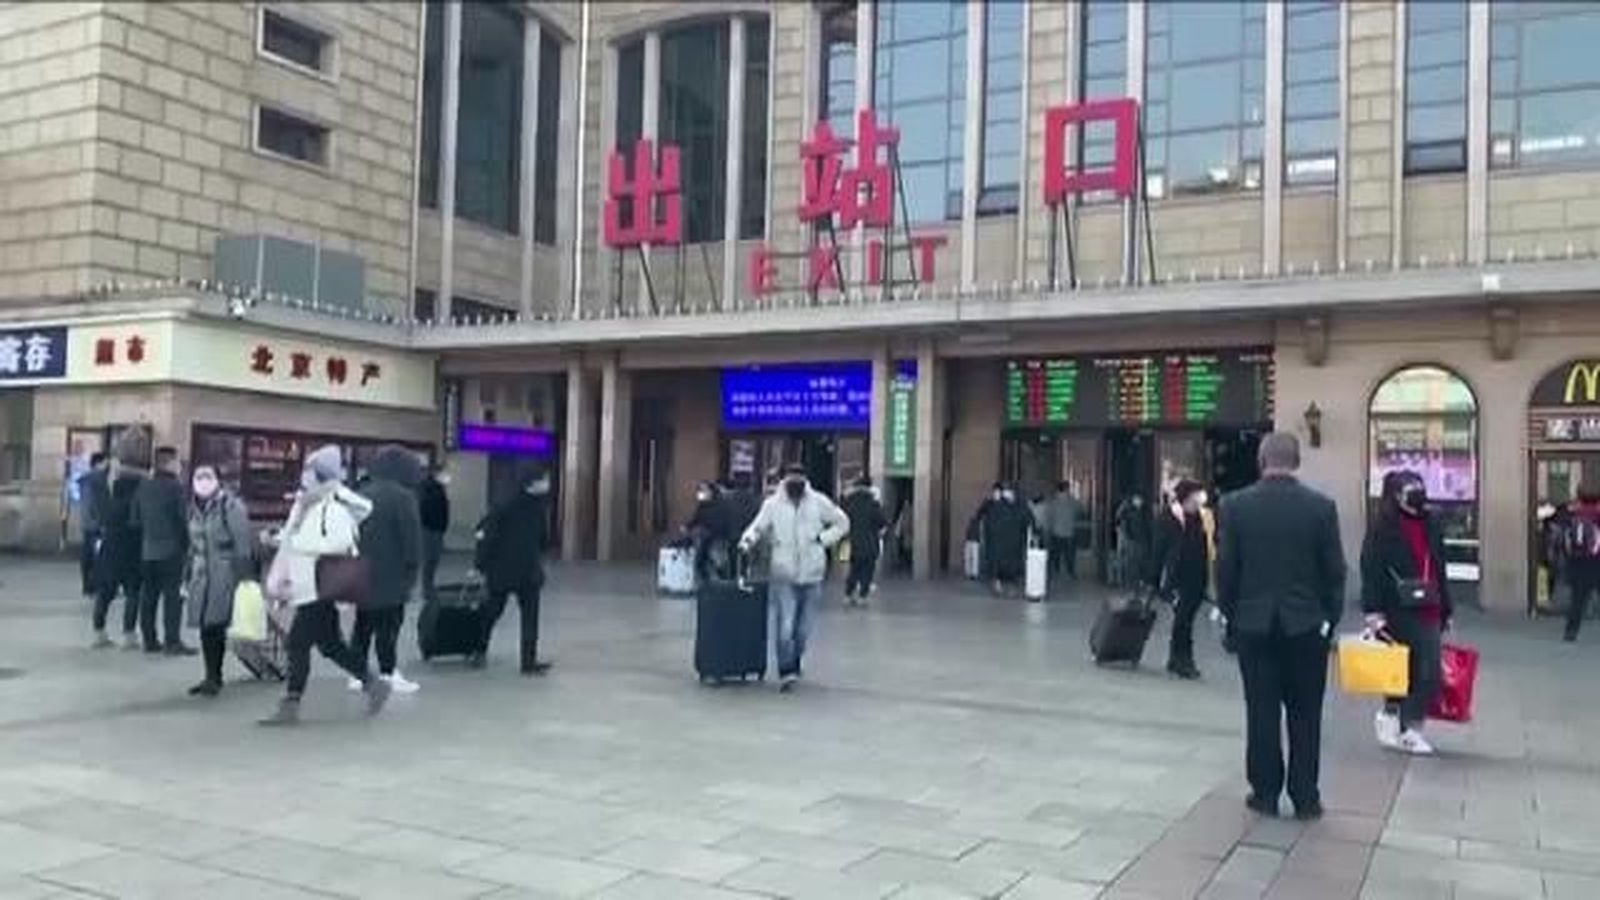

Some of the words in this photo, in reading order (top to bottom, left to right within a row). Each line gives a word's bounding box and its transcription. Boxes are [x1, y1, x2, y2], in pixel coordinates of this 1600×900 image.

[605, 98, 1138, 247] 出站口
[749, 237, 947, 295] EXIT
[251, 344, 380, 386] 北京特产
